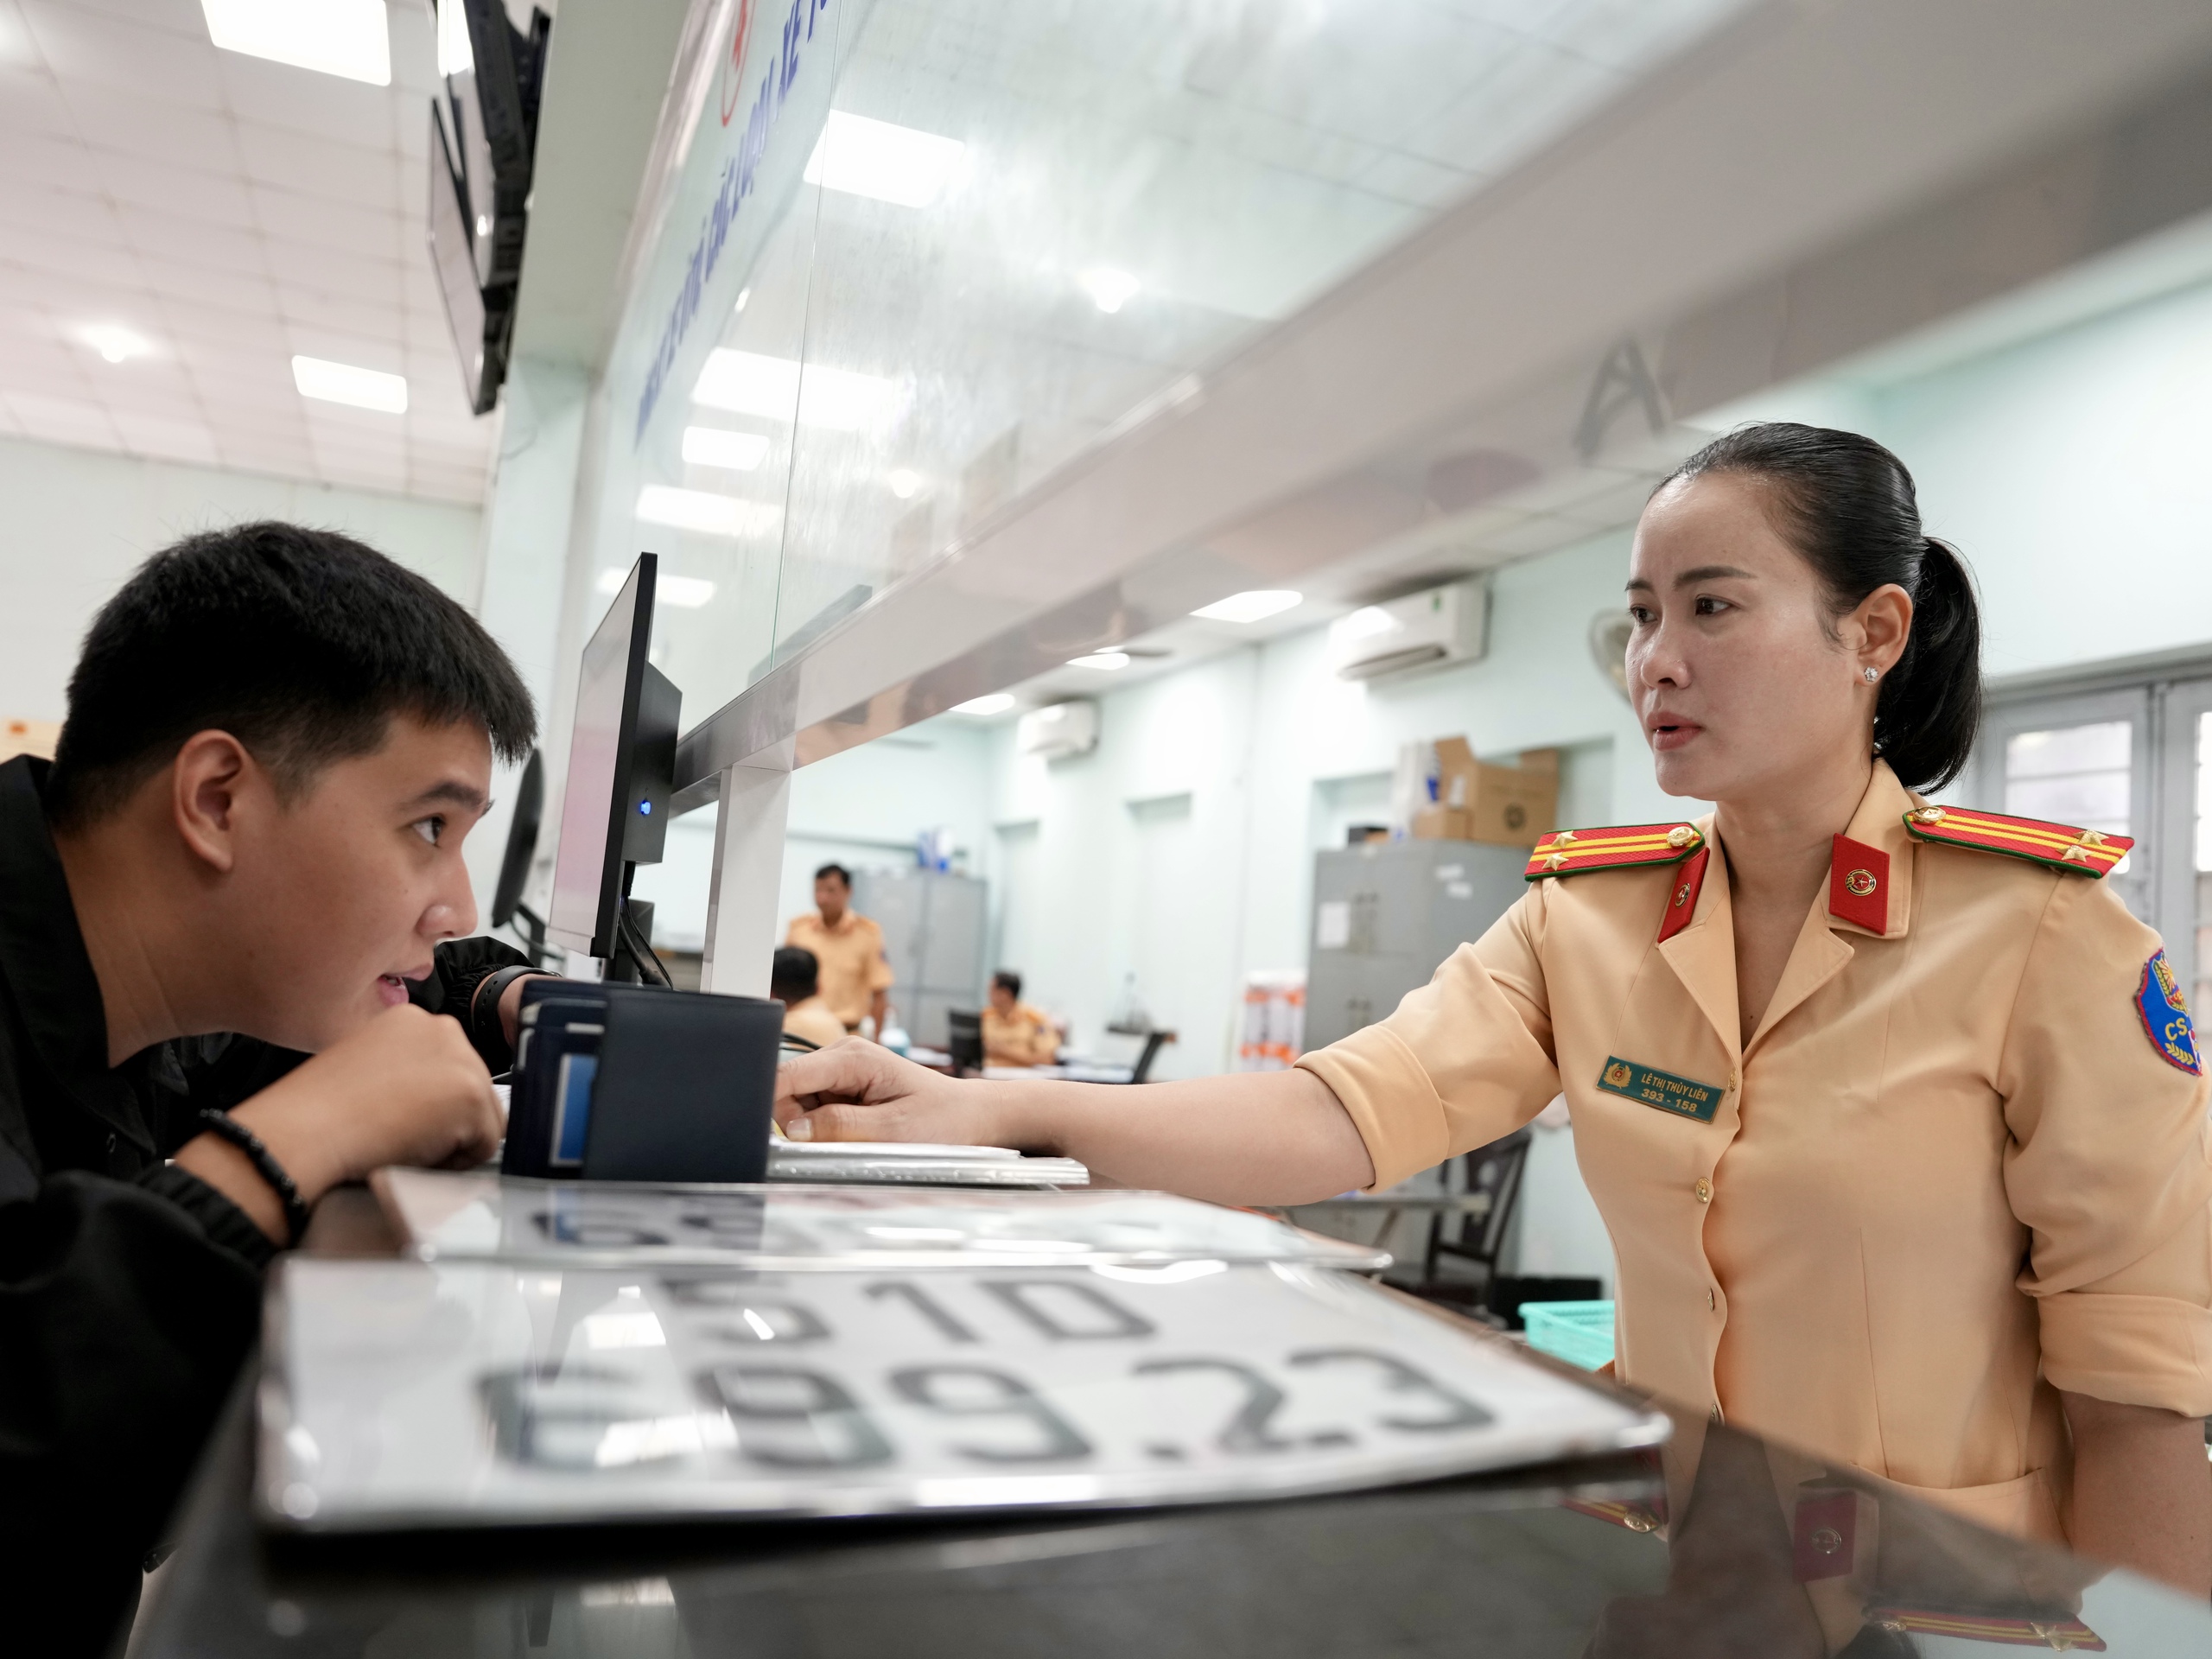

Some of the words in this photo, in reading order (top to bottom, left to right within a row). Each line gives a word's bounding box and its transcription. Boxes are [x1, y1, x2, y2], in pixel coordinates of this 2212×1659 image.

[1641, 1073, 1653, 1084] LÊ
[1652, 1077, 1667, 1091] THỊ
[1667, 1081, 1690, 1096] THÙY
[1688, 1088, 1708, 1102] LIÊN
[1641, 1089, 1665, 1103] 393
[1675, 1098, 1698, 1112] 158
[659, 1277, 1156, 1345] 51D
